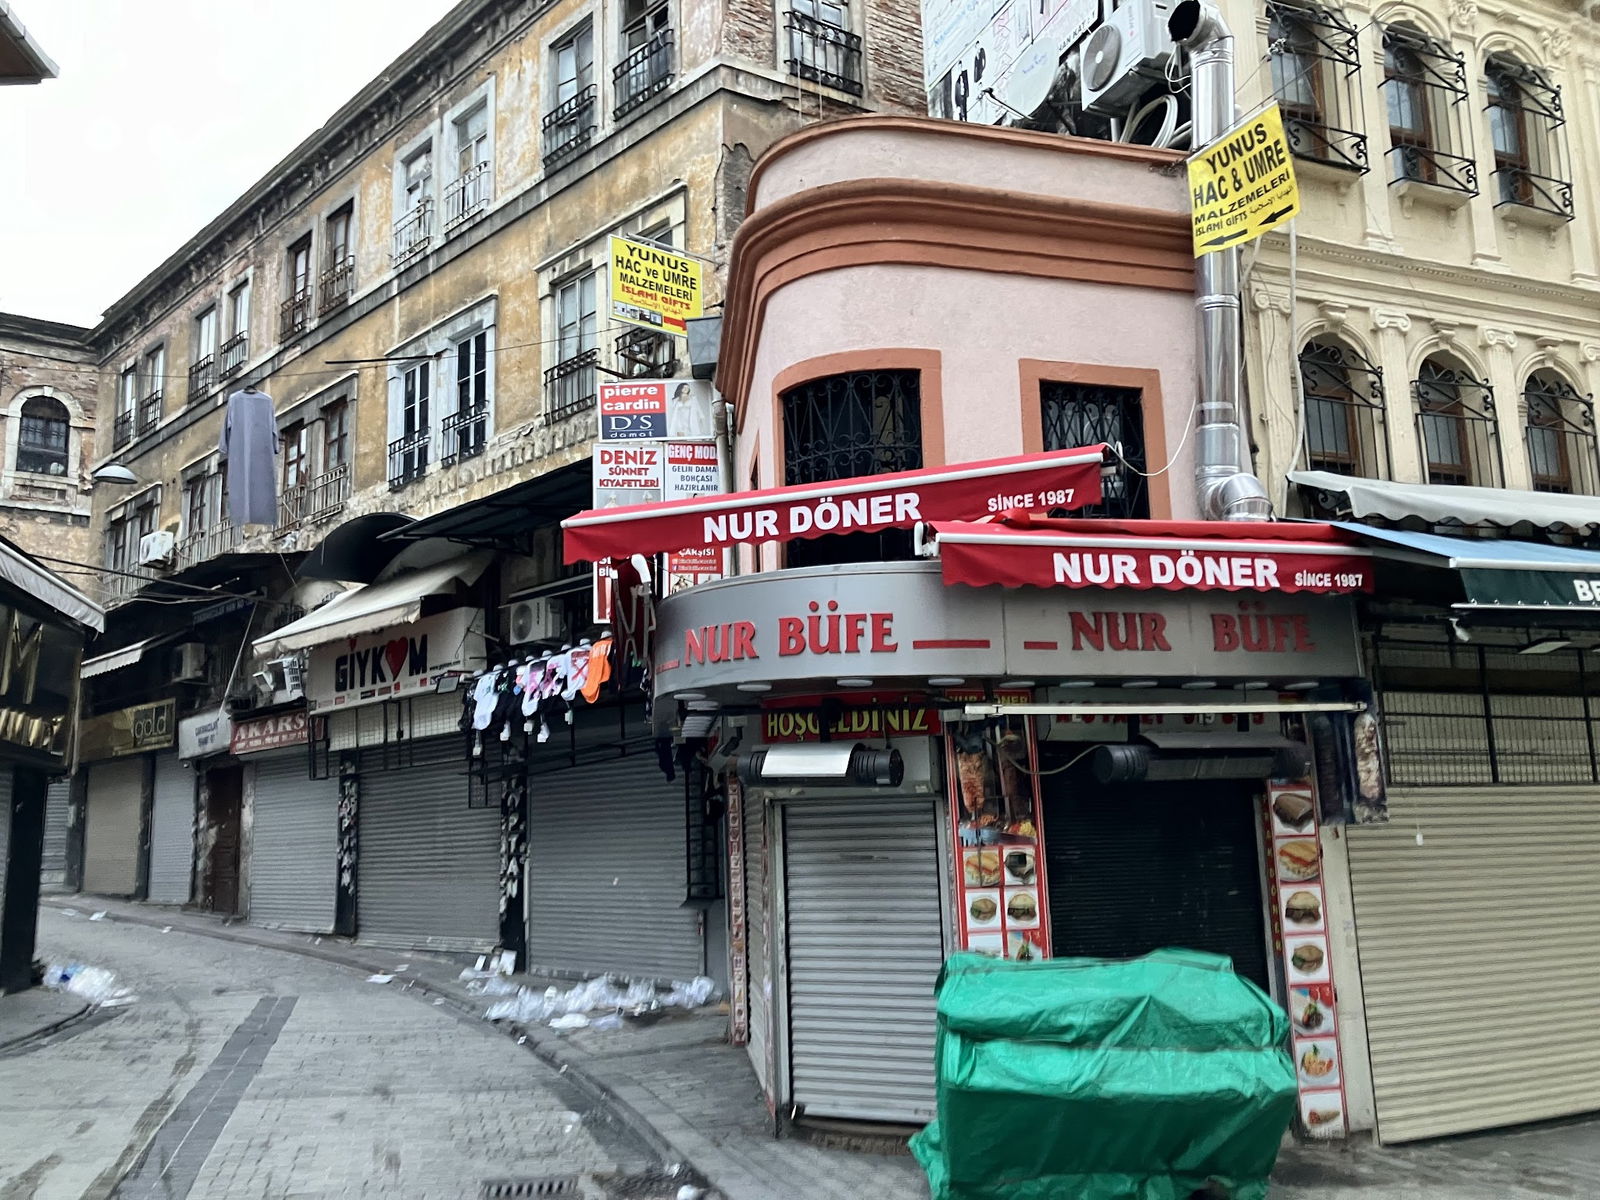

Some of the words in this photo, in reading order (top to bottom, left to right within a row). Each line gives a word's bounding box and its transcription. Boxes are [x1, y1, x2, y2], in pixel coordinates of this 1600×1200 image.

[1206, 123, 1267, 175] YUNUS
[1193, 175, 1229, 209] HAC
[1232, 168, 1243, 193] &
[1243, 138, 1286, 184] UMRE
[1194, 169, 1290, 225] MALZEMELERİ
[616, 255, 641, 274] HAC
[645, 267, 659, 280] ve
[662, 269, 697, 290] UMRE
[625, 244, 690, 273] YUNUS
[619, 272, 693, 302] MALZEMELERİ
[603, 399, 660, 411] cardin
[604, 385, 658, 400] pierre
[610, 415, 652, 430] D'S
[600, 446, 657, 465] DENİZ
[668, 445, 694, 462] GENÇ
[694, 446, 718, 459] MOD
[608, 466, 650, 476] SÜNNET
[674, 484, 718, 492] HAZIRLANIR
[1037, 489, 1075, 508] 1987
[703, 510, 779, 543] NUR
[788, 491, 922, 536] DÖNER
[1052, 552, 1141, 584] NUR
[1150, 549, 1280, 588] DÖNER
[1333, 573, 1364, 588] 1987
[684, 620, 759, 666] NUR
[778, 600, 899, 656] BÜFE
[1070, 611, 1172, 651] NUR
[1212, 601, 1316, 653] BÜFE
[134, 704, 167, 744] gold
